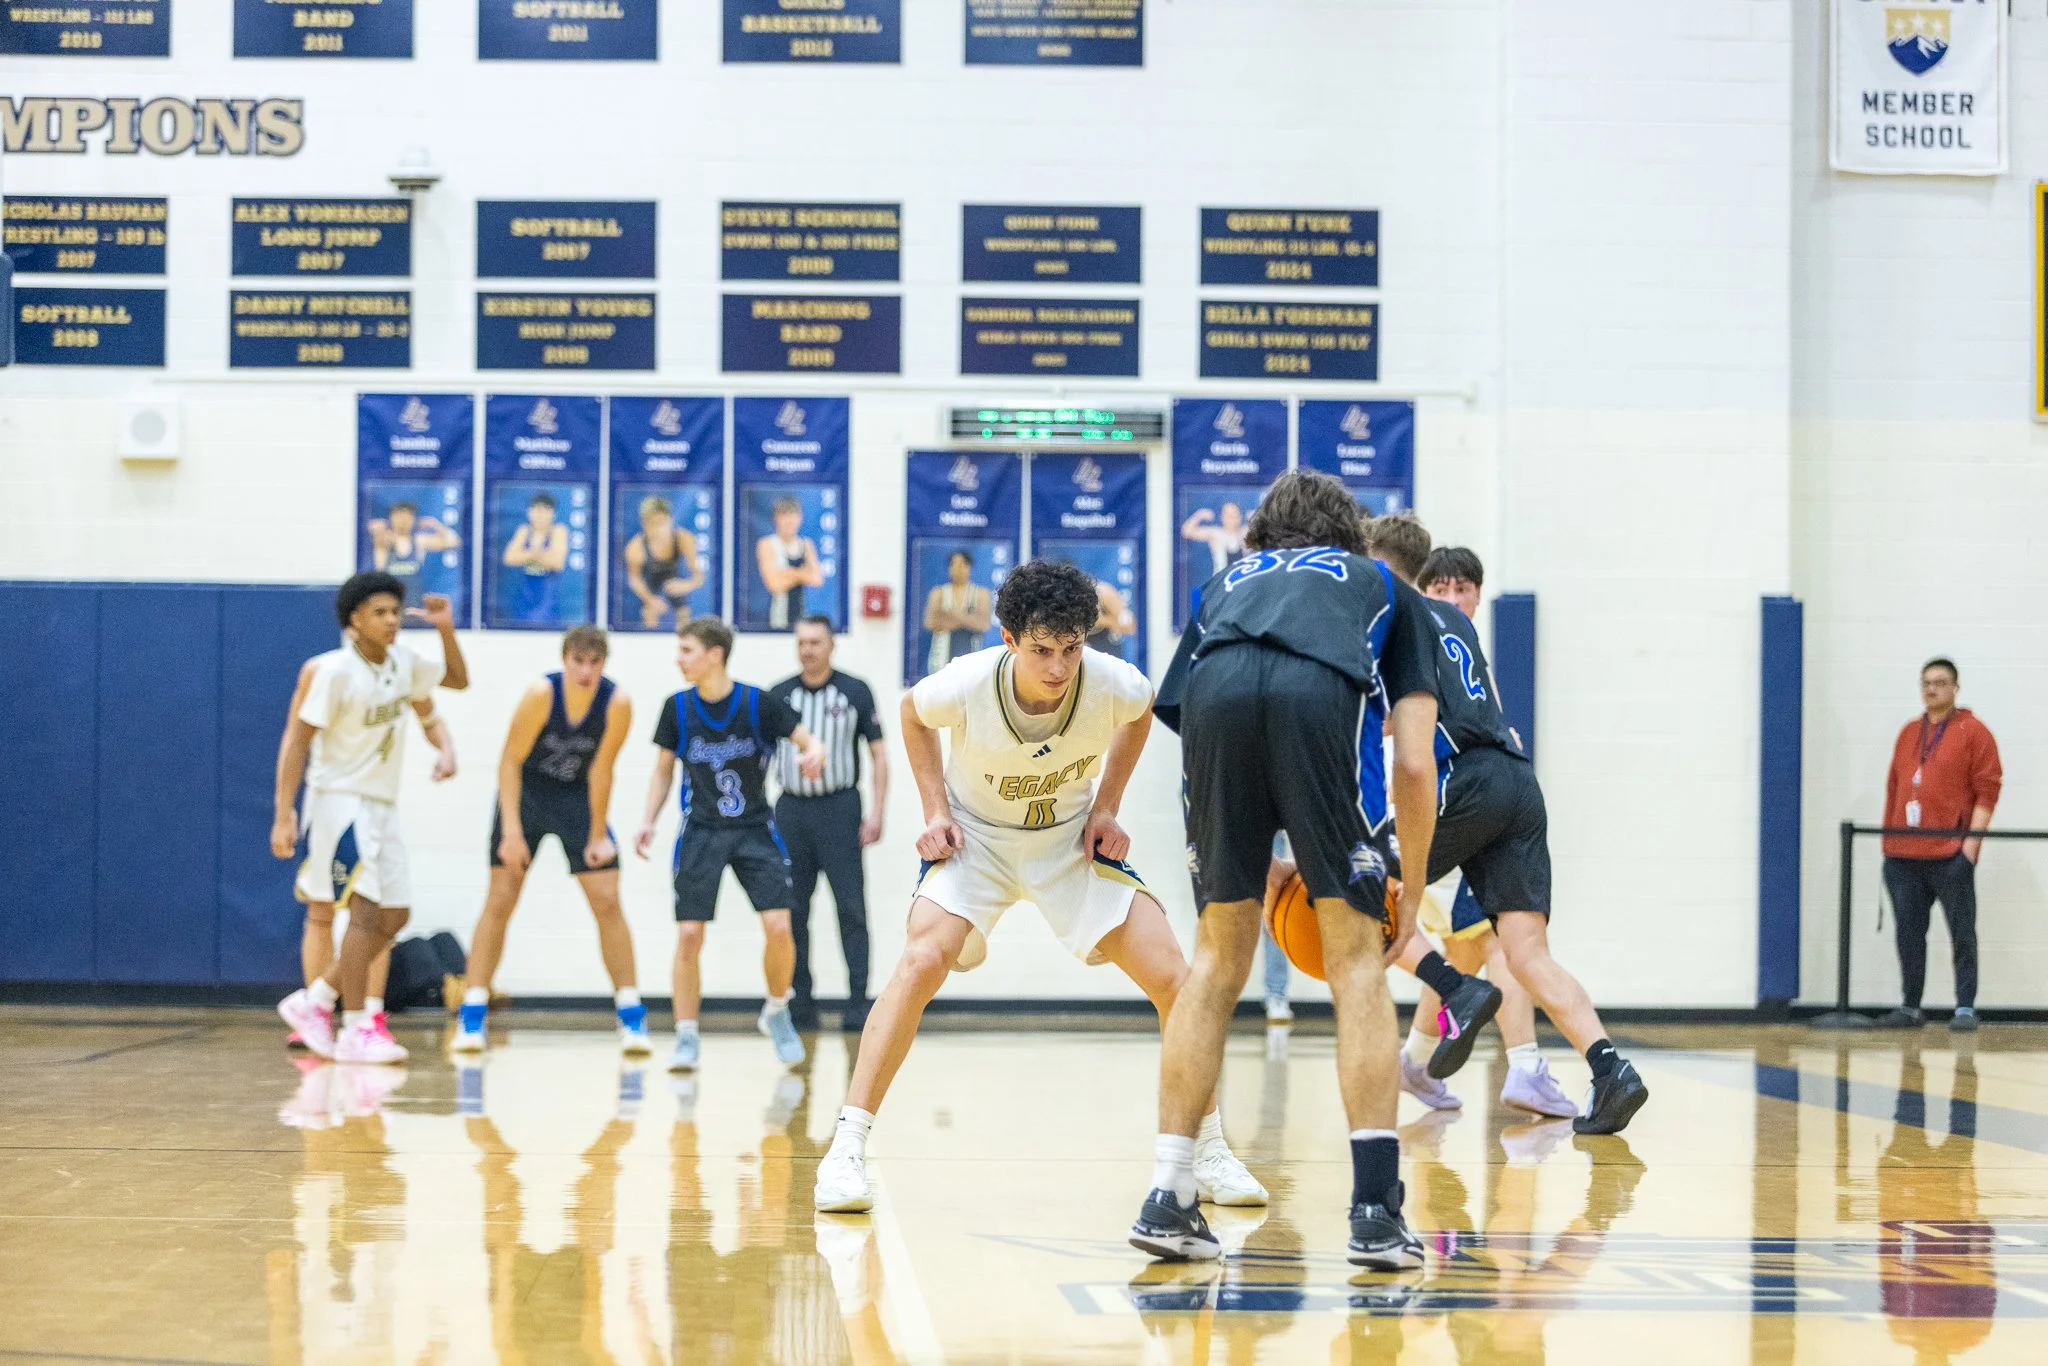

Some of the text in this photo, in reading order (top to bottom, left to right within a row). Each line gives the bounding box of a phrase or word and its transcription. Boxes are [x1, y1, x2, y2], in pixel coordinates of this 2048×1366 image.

[293, 9, 354, 28] BAND
[512, 0, 624, 19] SOFTBALL
[742, 15, 883, 33] BASKETBALL
[1862, 91, 1974, 116] MEMBER
[0, 97, 304, 156] MPIONS
[1866, 126, 1971, 149] SCHOOL
[510, 217, 623, 237] SOFTBALL
[261, 227, 382, 248] LONG JUMP
[21, 304, 132, 324] SOFTBALL
[715, 770, 746, 817] 3
